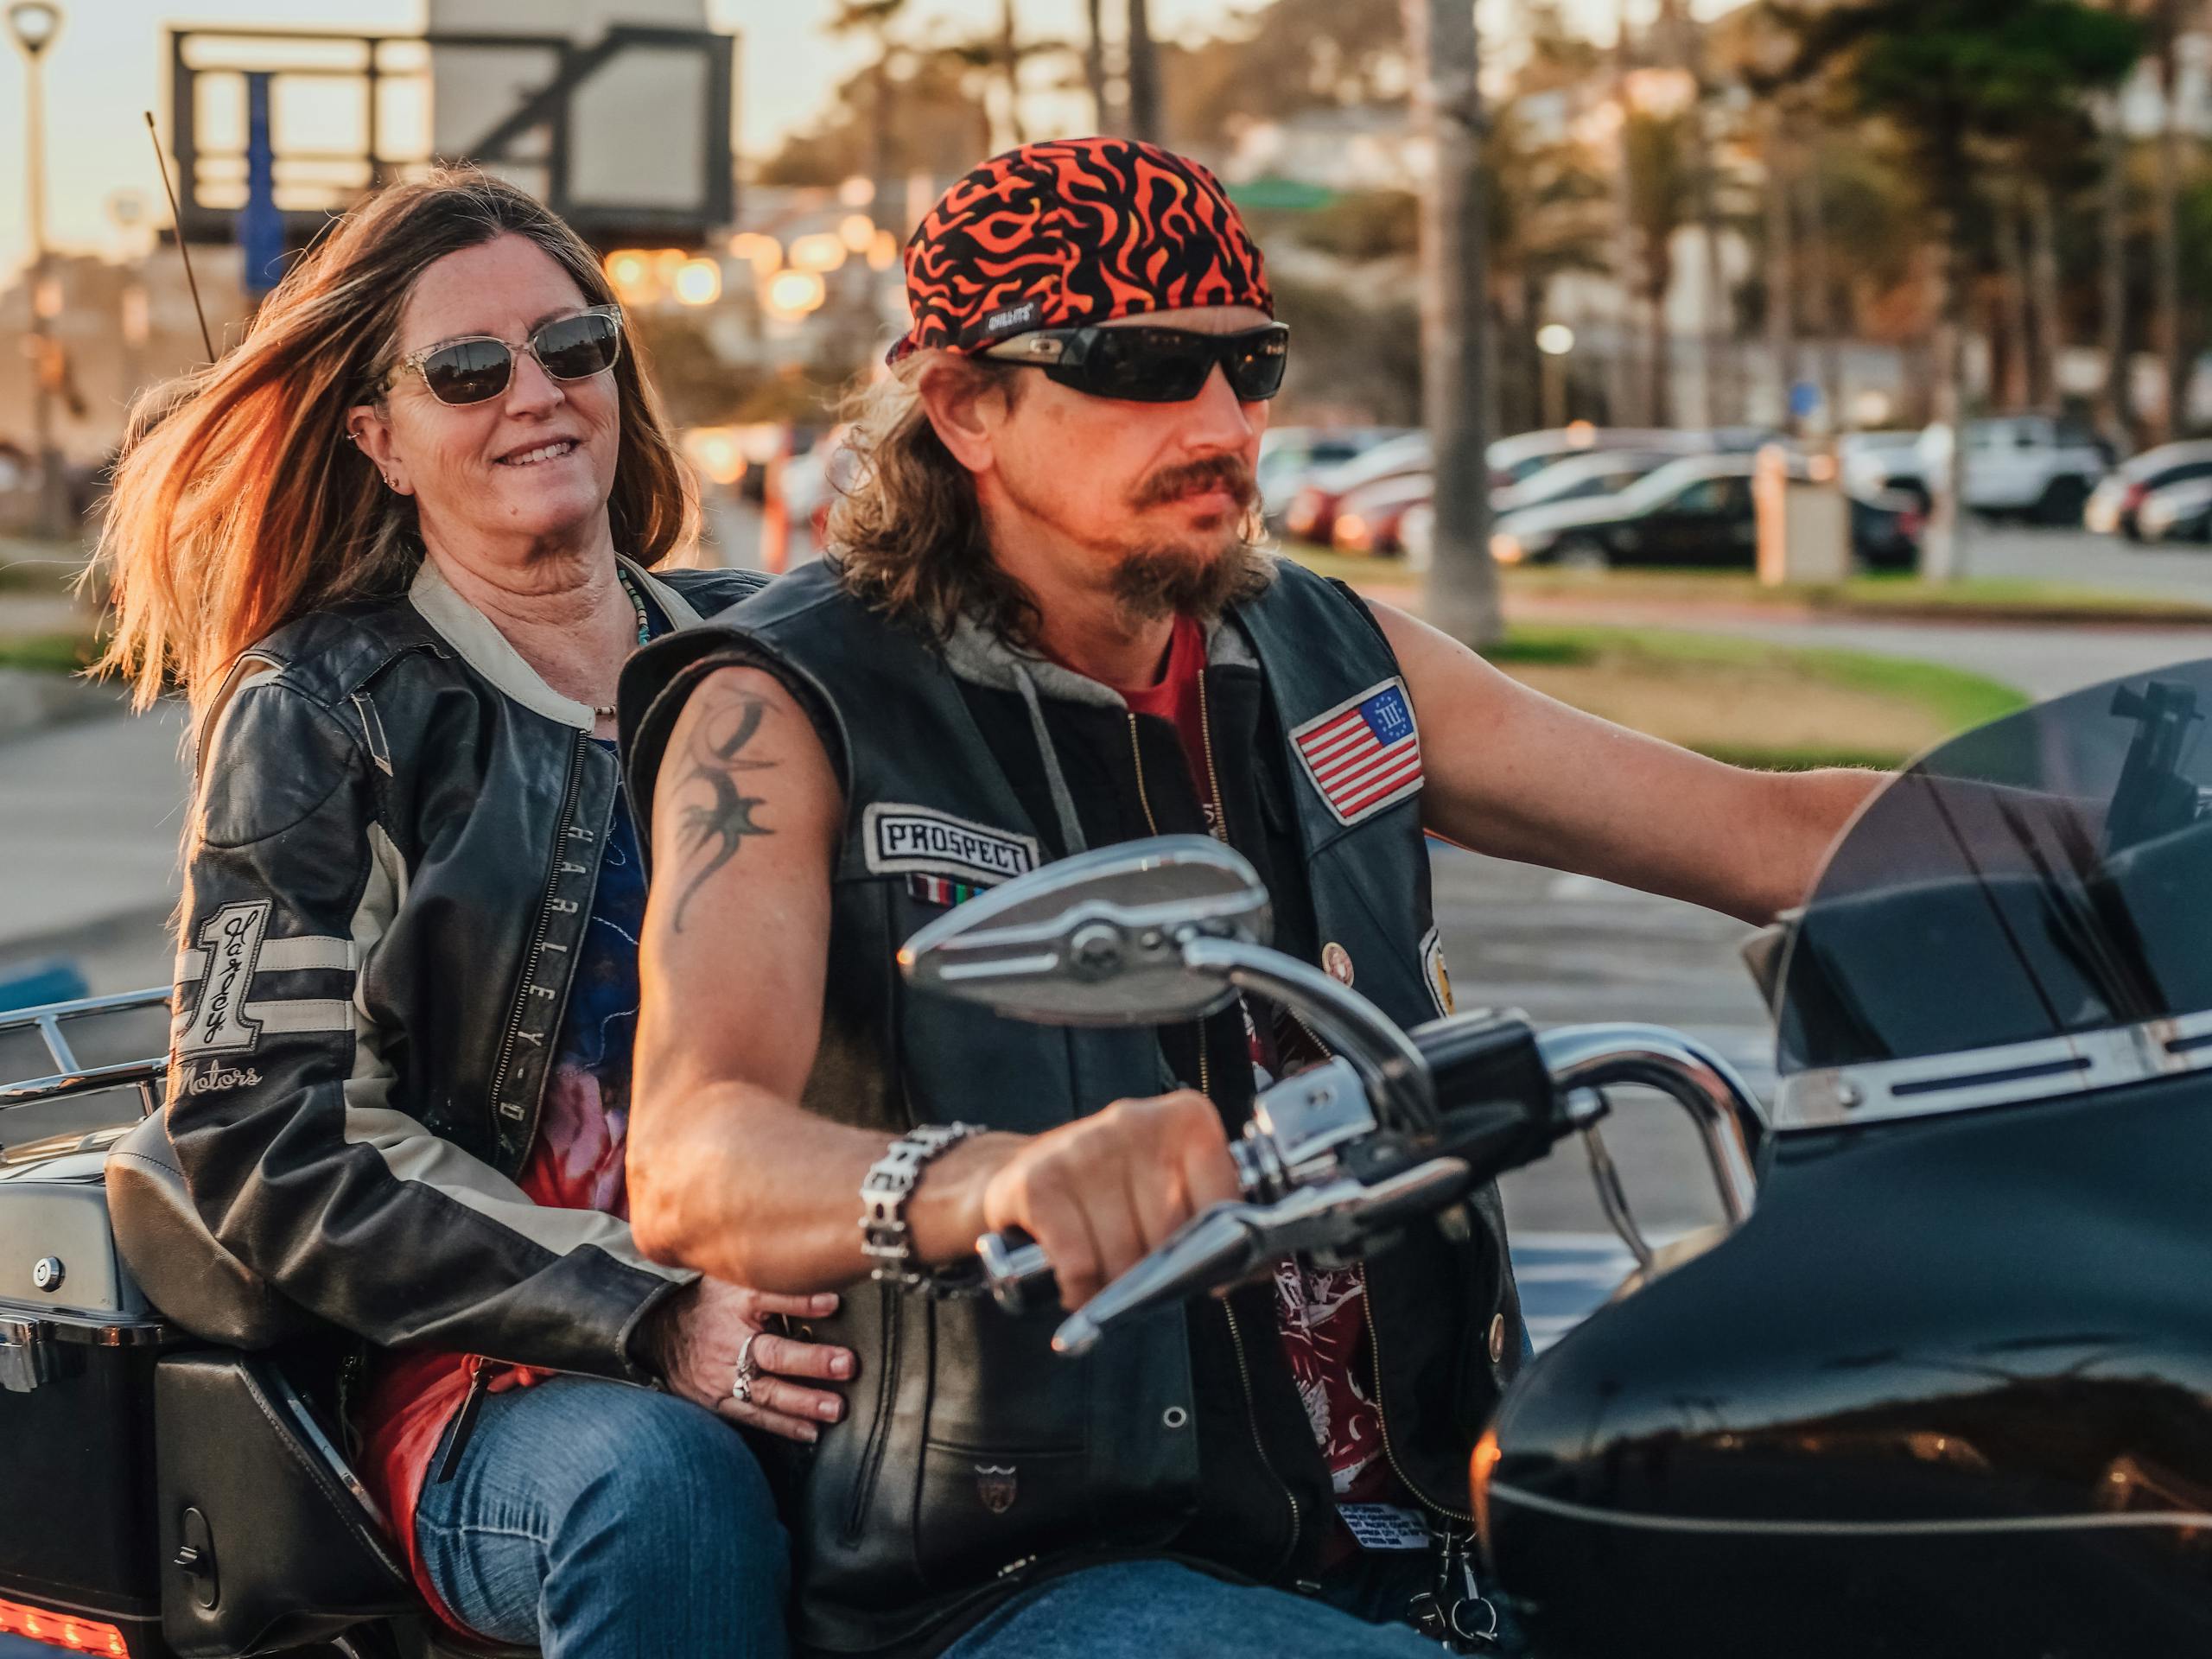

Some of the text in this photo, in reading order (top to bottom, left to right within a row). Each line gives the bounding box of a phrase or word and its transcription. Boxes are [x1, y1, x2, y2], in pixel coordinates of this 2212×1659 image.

[887, 824, 1021, 873] PROSPECT
[204, 910, 258, 1044] Harley
[179, 1059, 263, 1096] Motors
